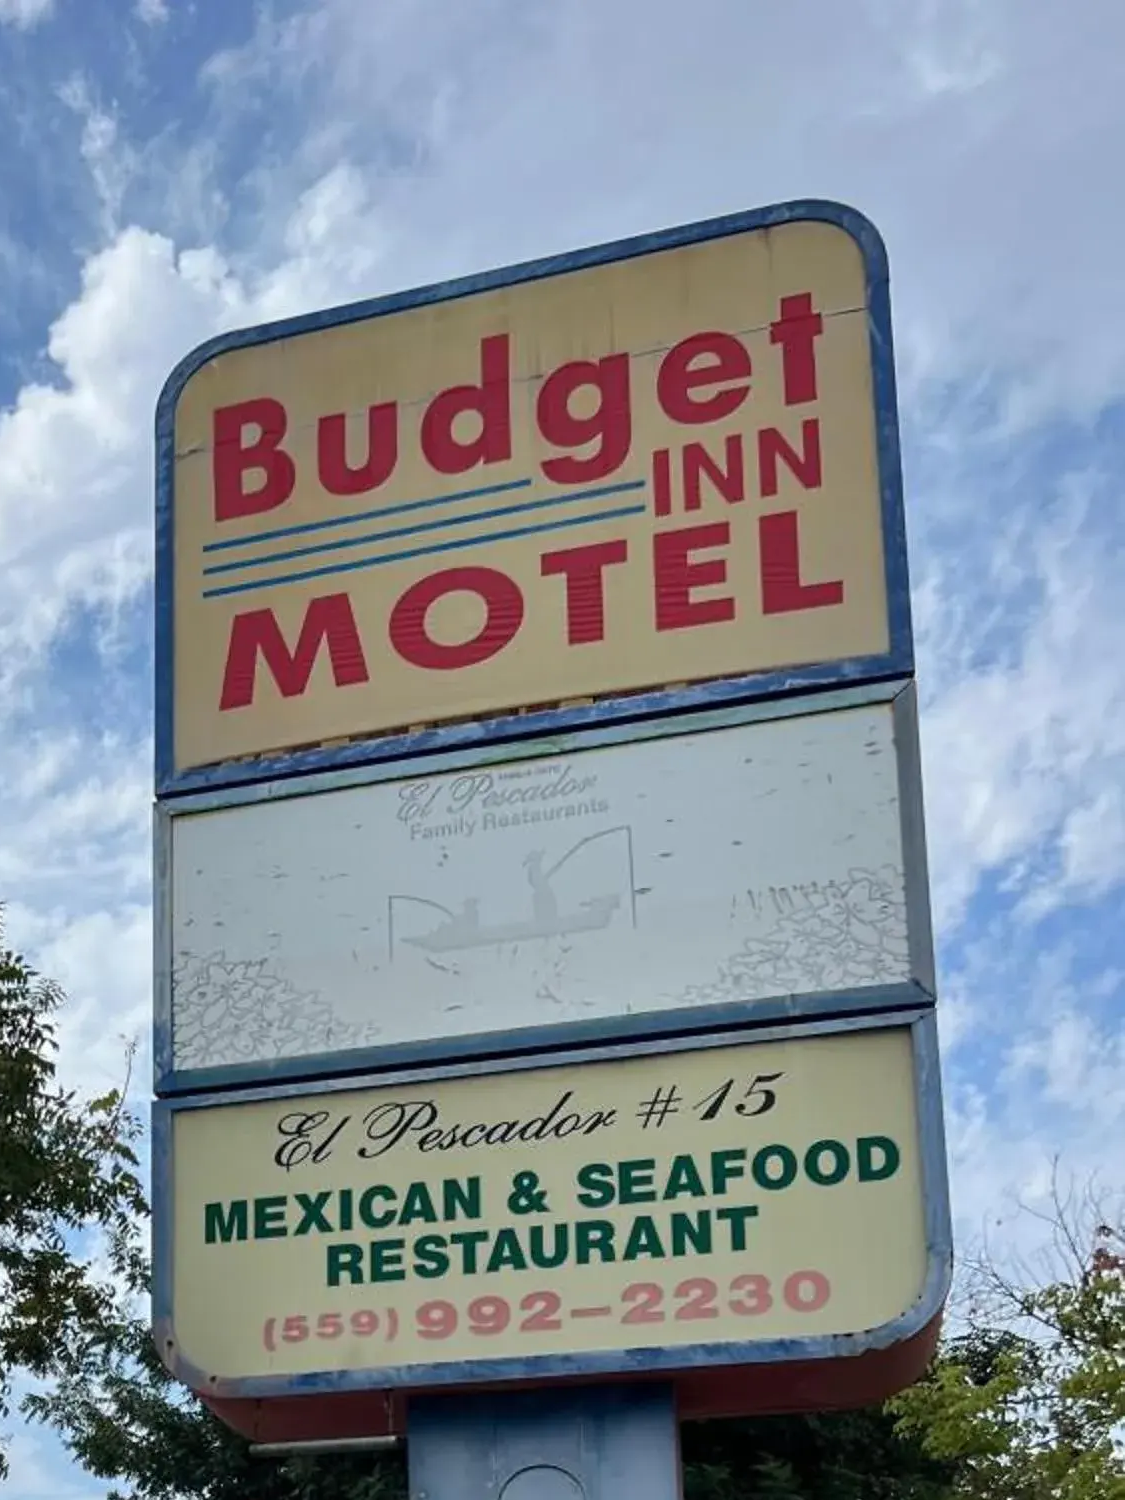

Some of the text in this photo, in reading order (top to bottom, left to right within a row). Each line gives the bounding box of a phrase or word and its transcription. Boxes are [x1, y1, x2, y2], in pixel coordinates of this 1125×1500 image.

[213, 288, 824, 523] Budget
[652, 417, 823, 518] INN
[218, 509, 845, 712] MOTEL
[396, 765, 599, 825] El Pescador
[410, 797, 610, 841] Family Restaurants
[274, 1111, 352, 1172] El
[357, 1090, 617, 1159] Pescador
[203, 1134, 901, 1245] MEXICAN & SEAFOOD
[326, 1204, 760, 1287] RESTAURANT
[262, 1269, 831, 1353] (559) 992-2230
